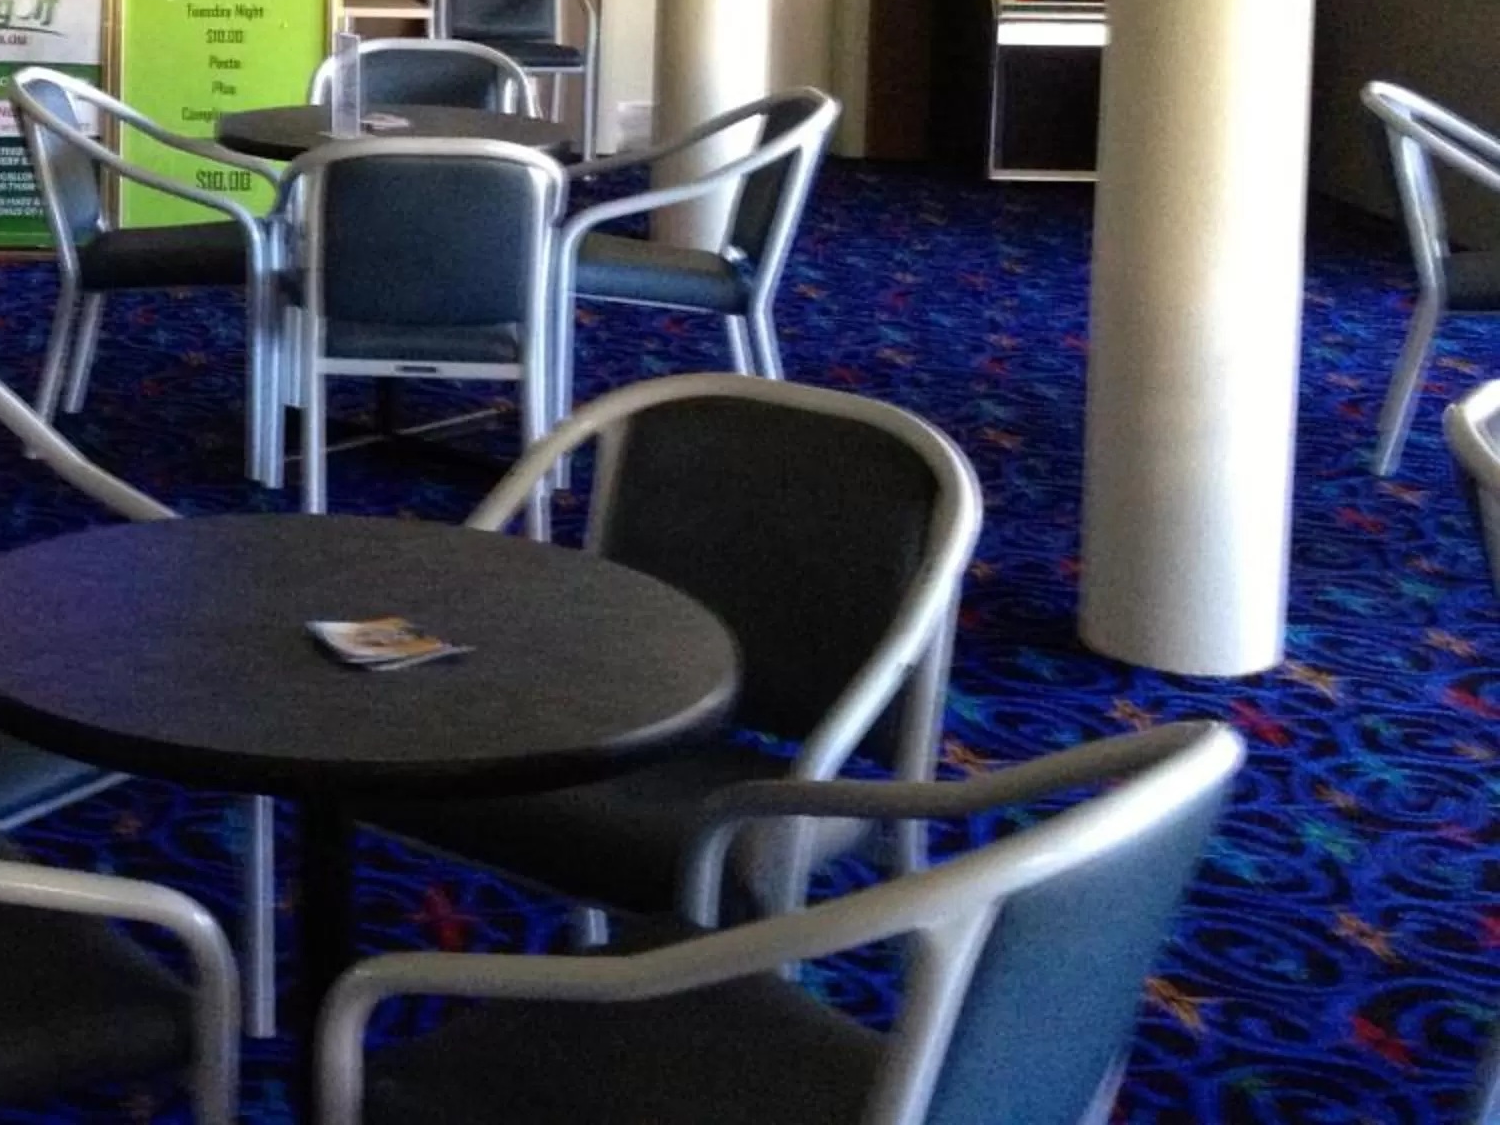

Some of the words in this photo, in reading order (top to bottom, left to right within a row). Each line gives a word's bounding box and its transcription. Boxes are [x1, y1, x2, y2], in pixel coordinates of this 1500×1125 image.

[187, 3, 231, 20] Tuesday
[235, 3, 264, 21] Night
[206, 28, 244, 43] $10.00
[195, 170, 251, 192] $10.00
